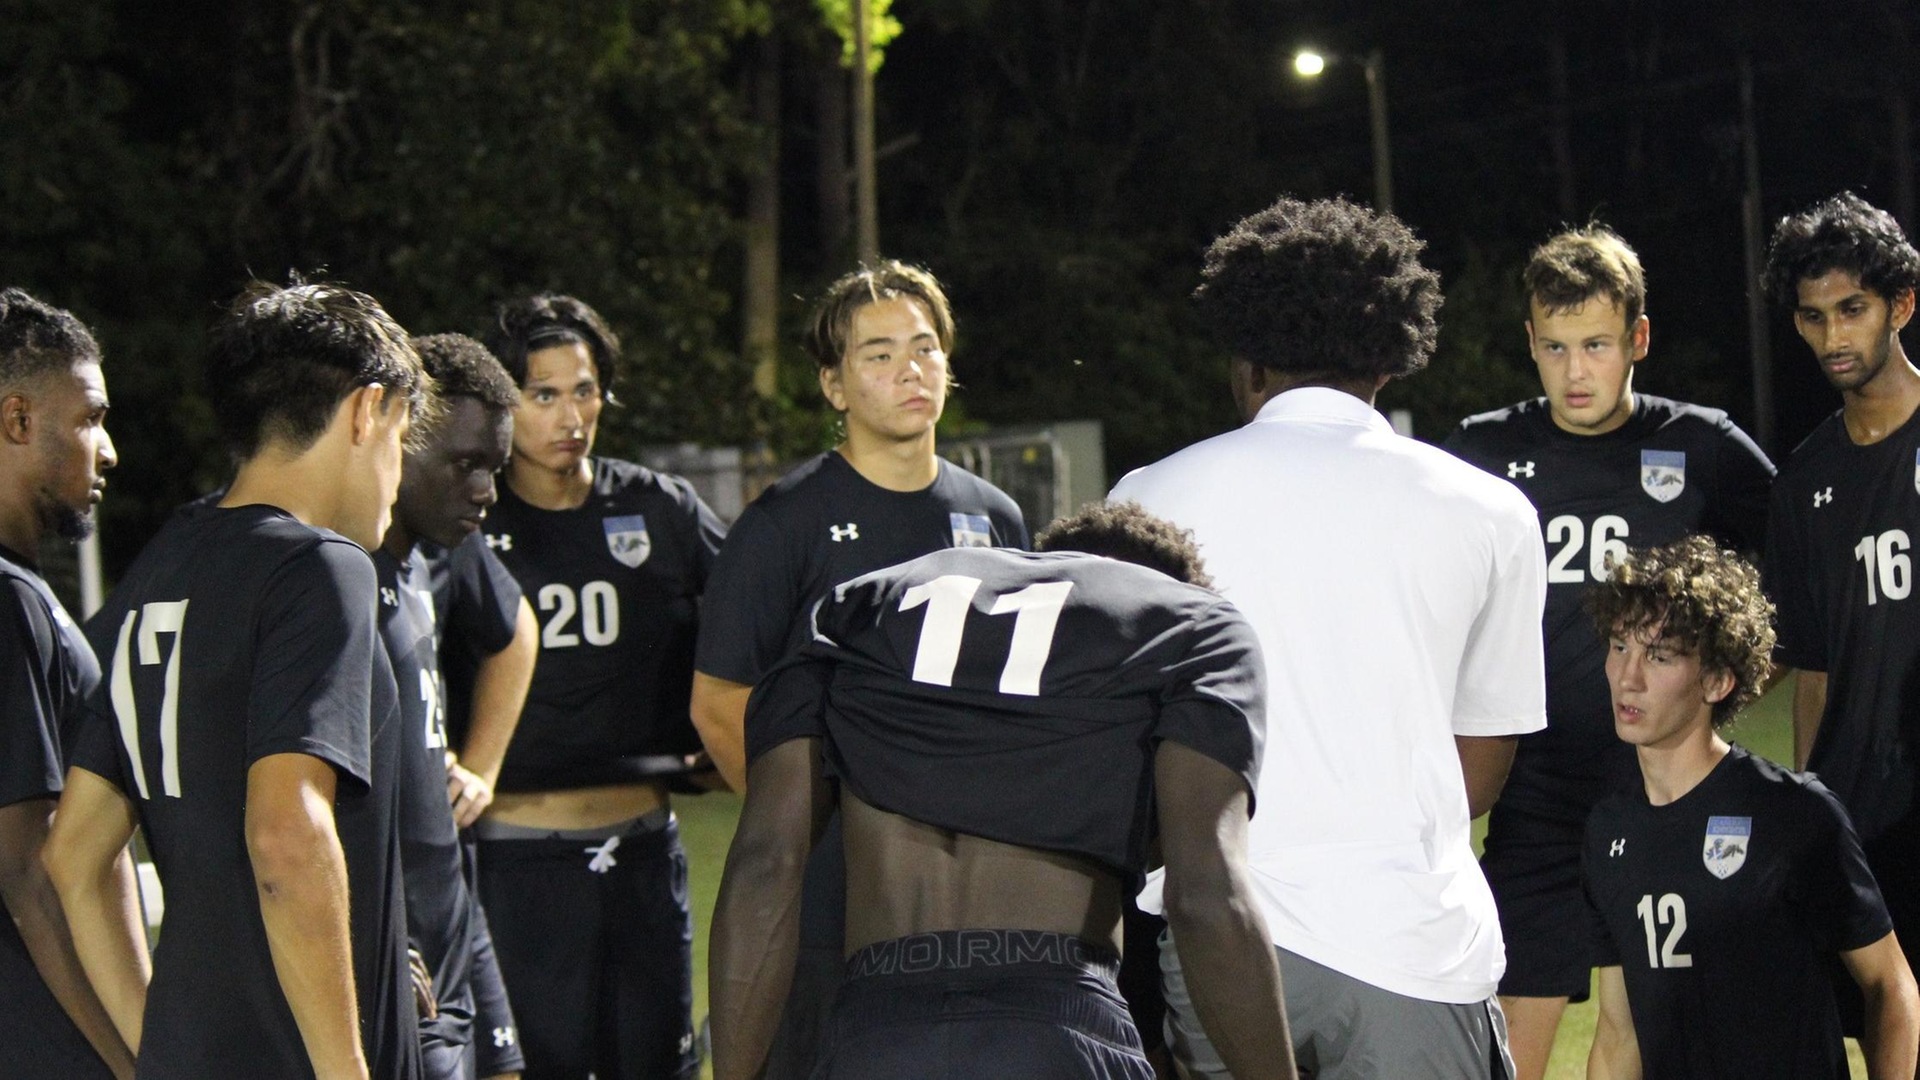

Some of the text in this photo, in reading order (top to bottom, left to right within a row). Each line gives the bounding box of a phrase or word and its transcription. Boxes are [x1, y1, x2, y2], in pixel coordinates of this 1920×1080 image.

[1547, 515, 1629, 583] 26
[1855, 529, 1911, 605] 16
[538, 580, 619, 649] 20
[898, 575, 1074, 696] 11
[110, 599, 189, 800] 17
[1637, 893, 1692, 968] 12
